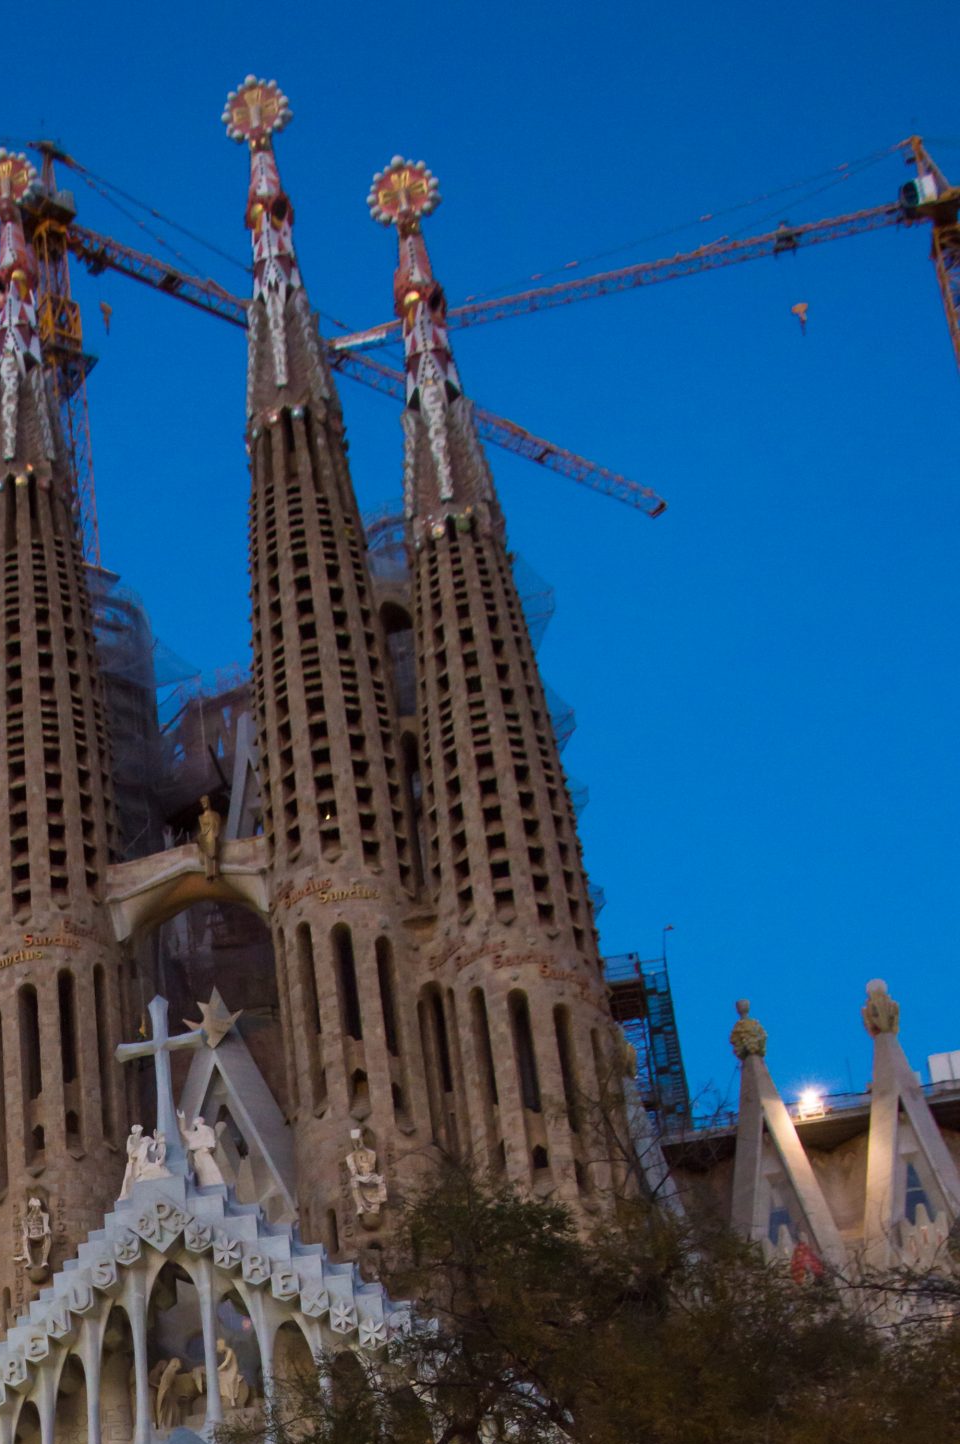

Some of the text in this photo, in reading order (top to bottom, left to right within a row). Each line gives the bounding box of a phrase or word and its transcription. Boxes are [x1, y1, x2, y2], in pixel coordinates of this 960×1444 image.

[318, 884, 381, 905] Sanctus
[23, 934, 82, 949] Sanctus
[246, 1254, 329, 1313] REX
